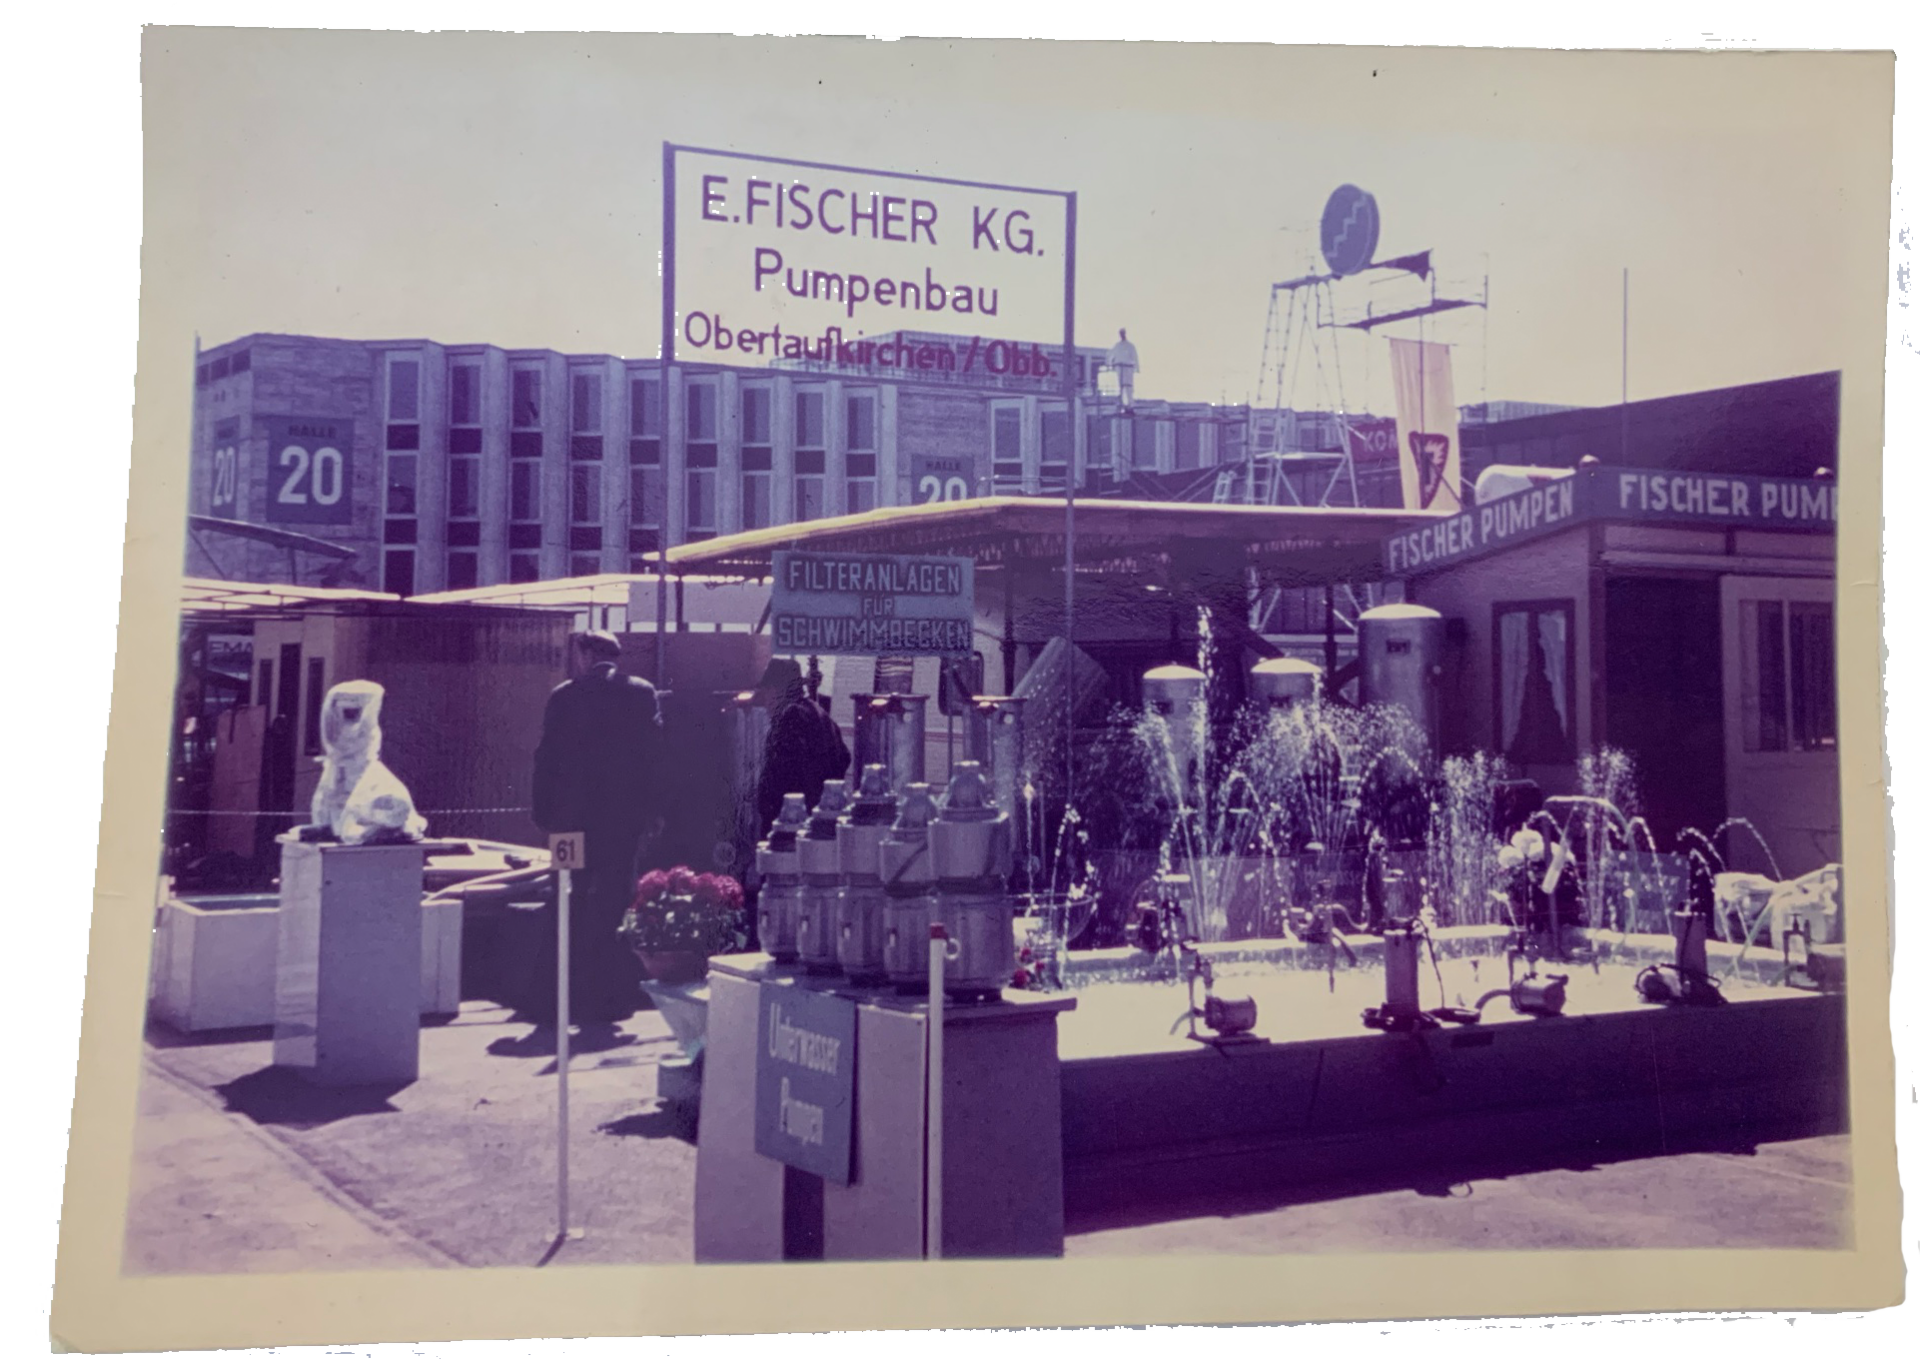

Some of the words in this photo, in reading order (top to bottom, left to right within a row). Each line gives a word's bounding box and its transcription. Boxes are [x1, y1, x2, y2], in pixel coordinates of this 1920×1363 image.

[702, 175, 938, 246] E.FISCHER
[972, 206, 1045, 256] KG.
[754, 247, 998, 318] Pumpenbau
[213, 446, 235, 507] 20
[277, 445, 344, 505] 20
[1619, 473, 1750, 516] FISCHER
[1388, 514, 1474, 573] FISCHER
[1481, 481, 1573, 544] PUMPEN
[788, 560, 961, 593] FILTERANLAGEN
[778, 618, 970, 648] SCHWIMMBECKEN
[556, 839, 575, 862] 61
